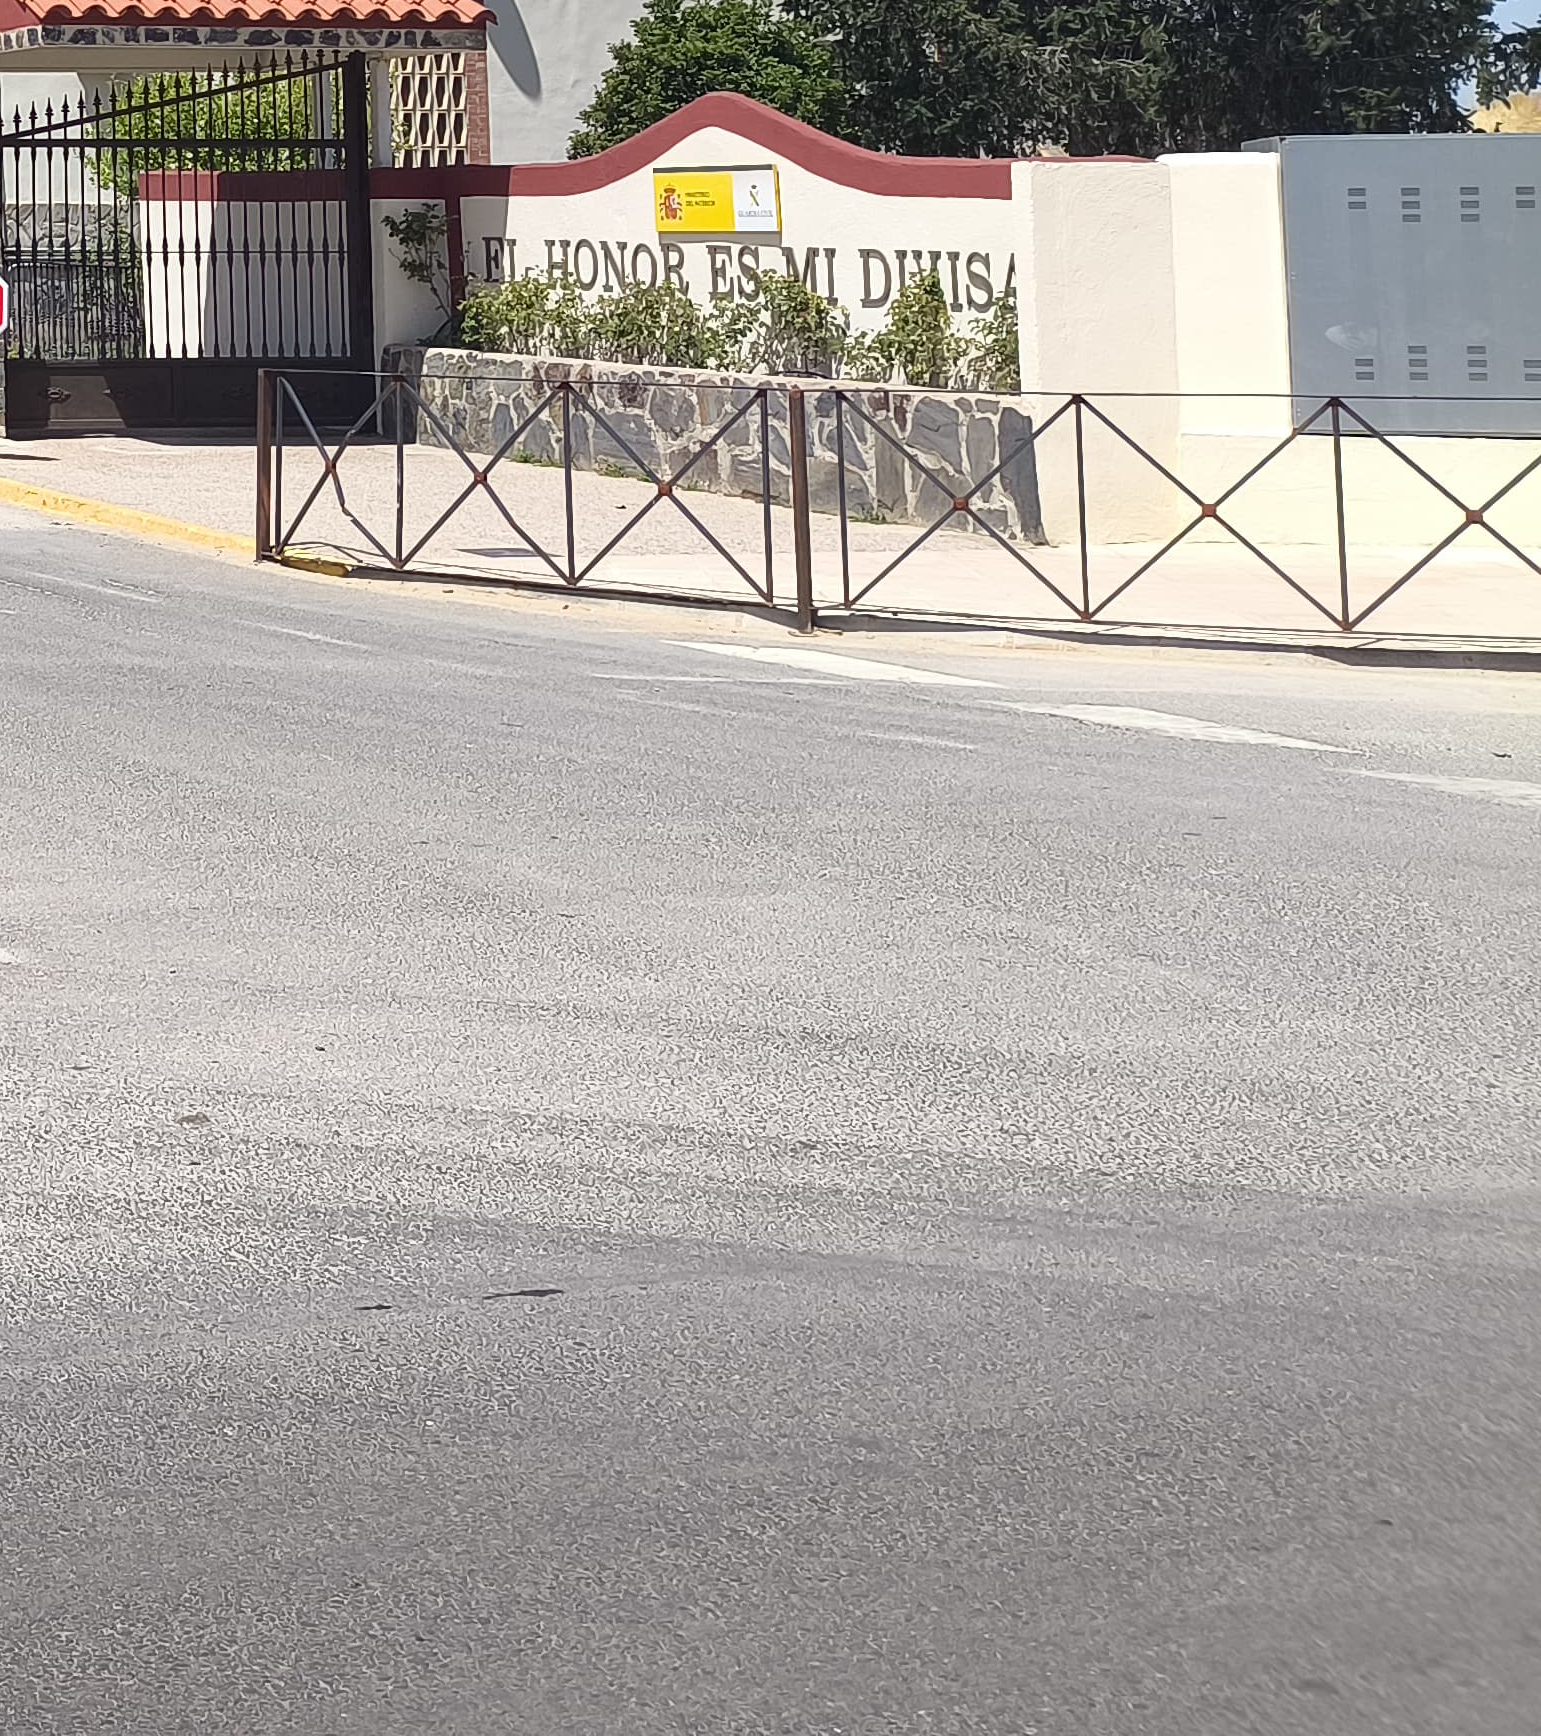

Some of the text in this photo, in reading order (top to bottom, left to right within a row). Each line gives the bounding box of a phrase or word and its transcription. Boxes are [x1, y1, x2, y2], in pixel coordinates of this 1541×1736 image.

[544, 238, 689, 297] HONOR
[706, 245, 760, 303] ES
[782, 246, 838, 306] MI
